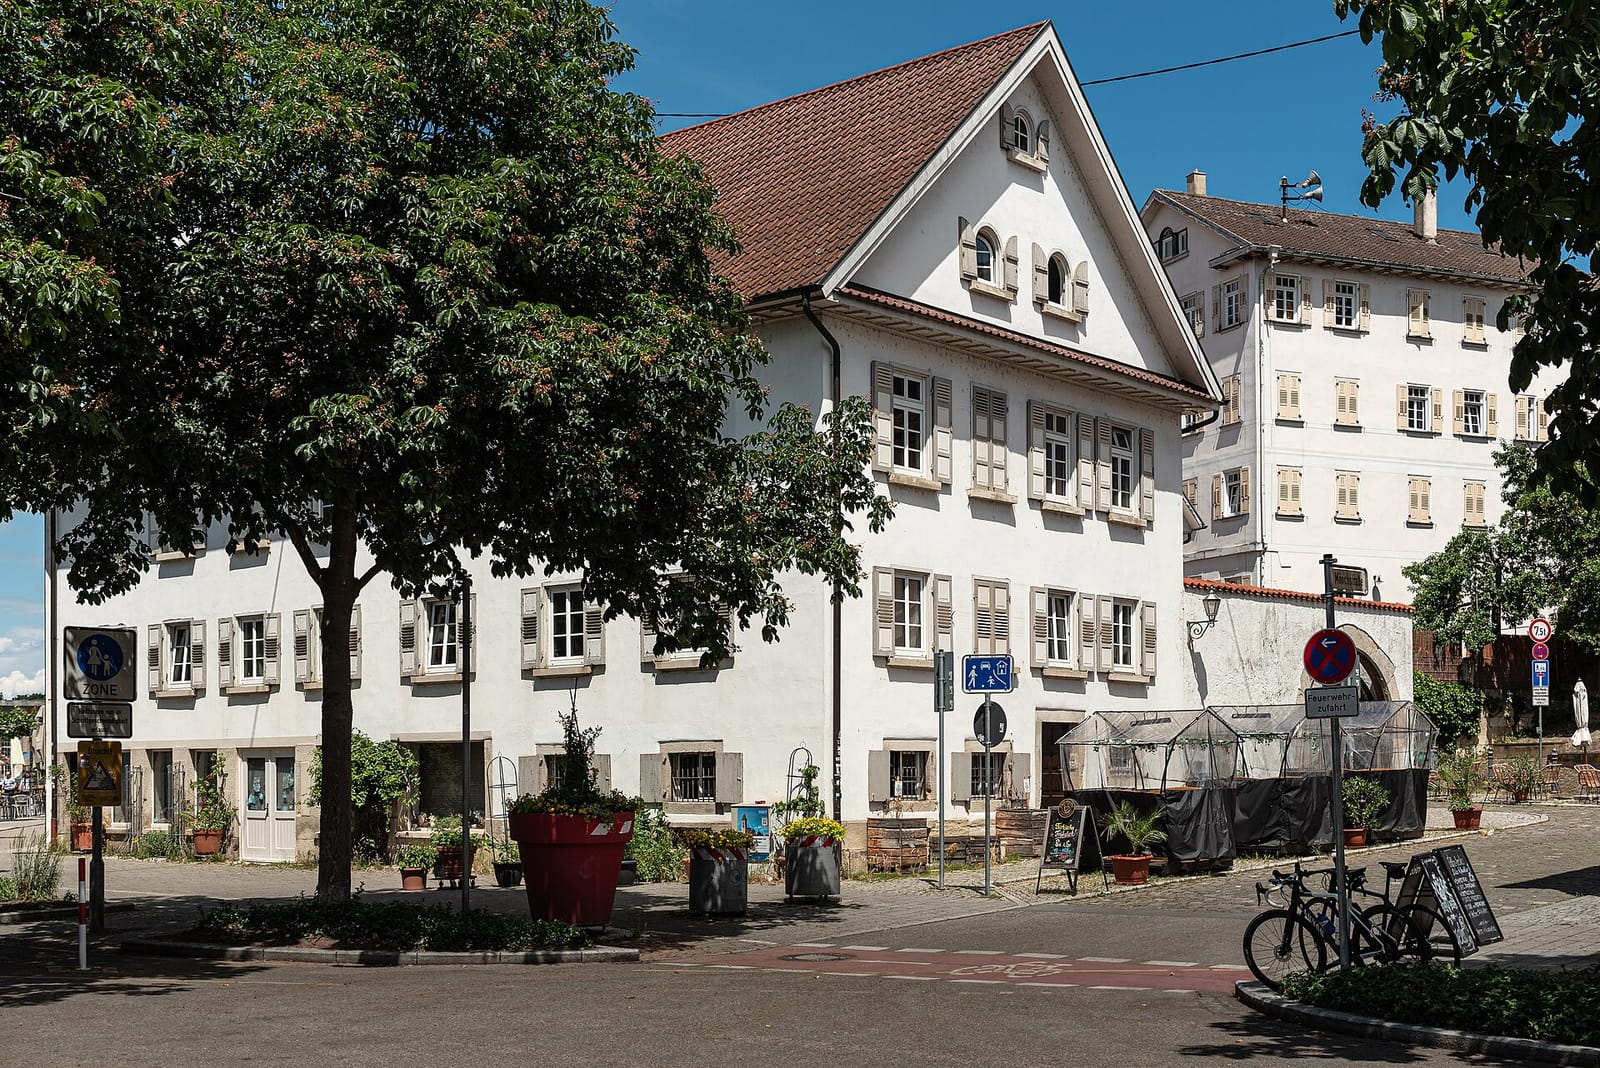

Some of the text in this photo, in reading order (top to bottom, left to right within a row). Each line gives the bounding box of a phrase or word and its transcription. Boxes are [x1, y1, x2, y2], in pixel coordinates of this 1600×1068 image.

[82, 683, 118, 696] ZONE
[1307, 692, 1356, 703] Feuerwehr-
[1317, 703, 1347, 713] zufahrt
